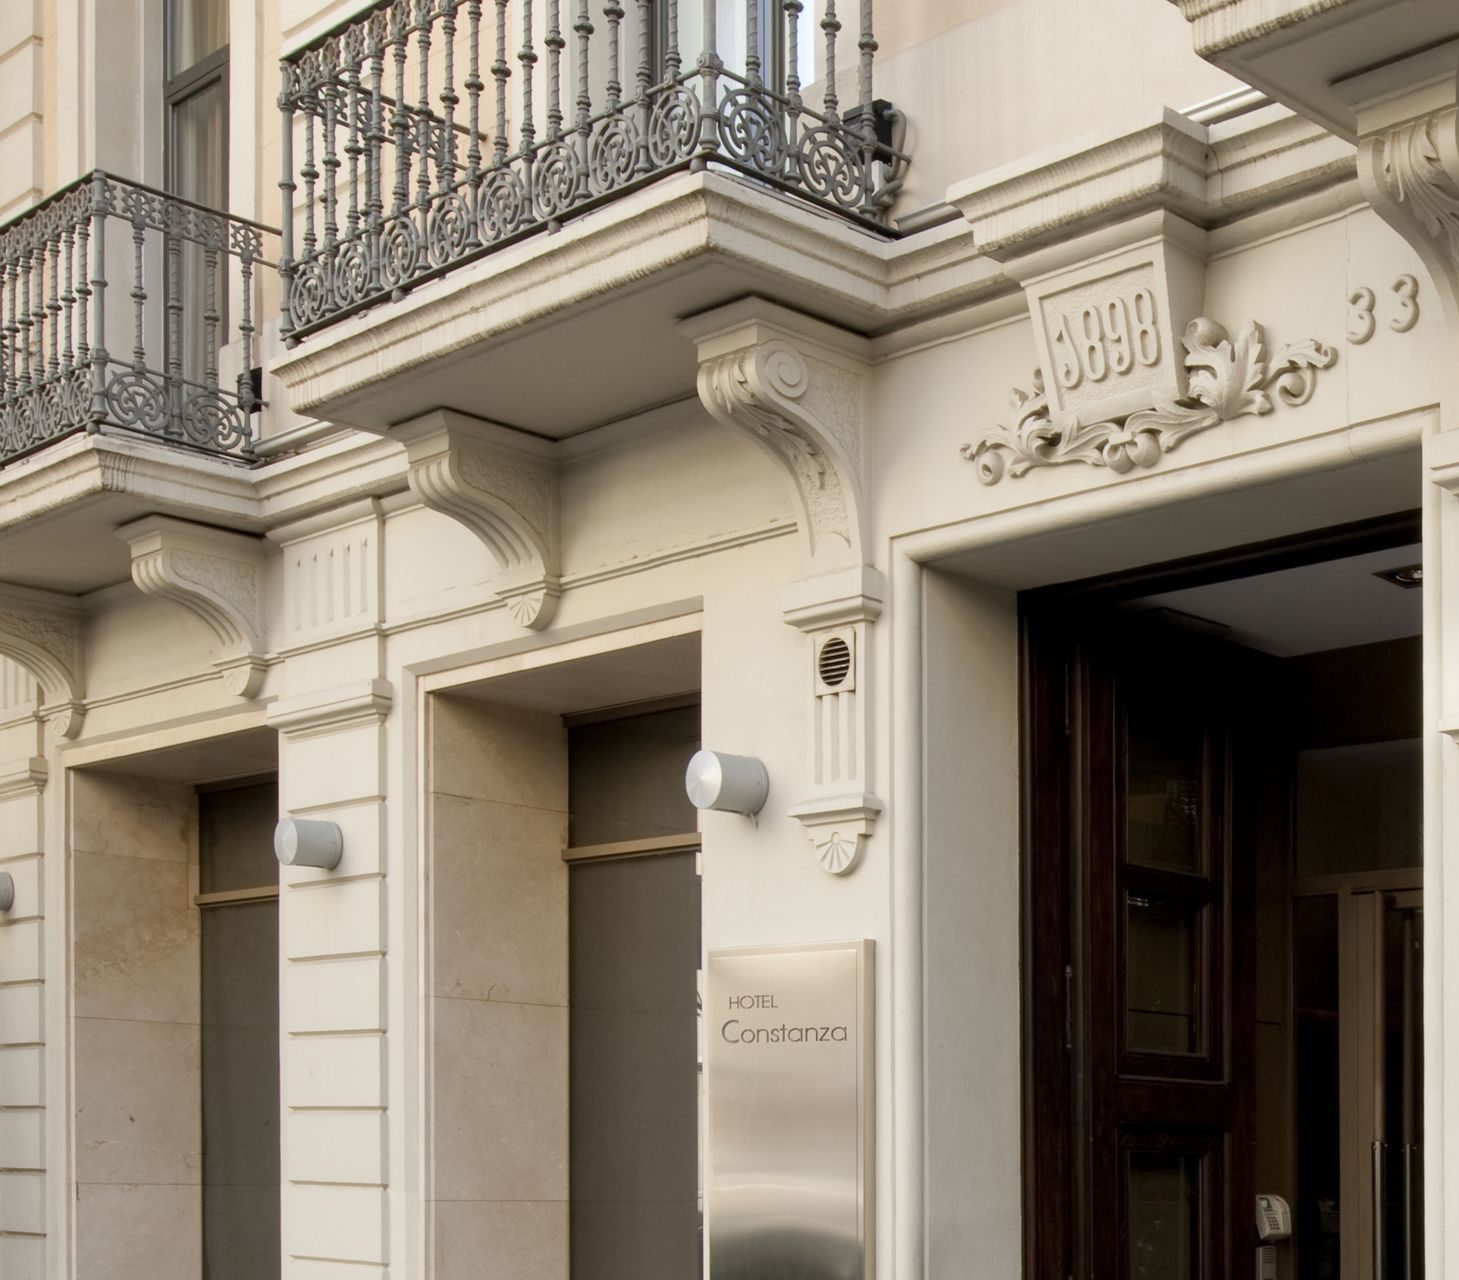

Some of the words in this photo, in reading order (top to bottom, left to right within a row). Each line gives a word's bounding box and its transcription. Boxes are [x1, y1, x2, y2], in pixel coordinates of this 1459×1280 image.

[1346, 273, 1420, 345] 33
[1055, 287, 1161, 389] 1898
[728, 994, 779, 1010] HOTEL
[721, 1019, 848, 1044] Constanza
